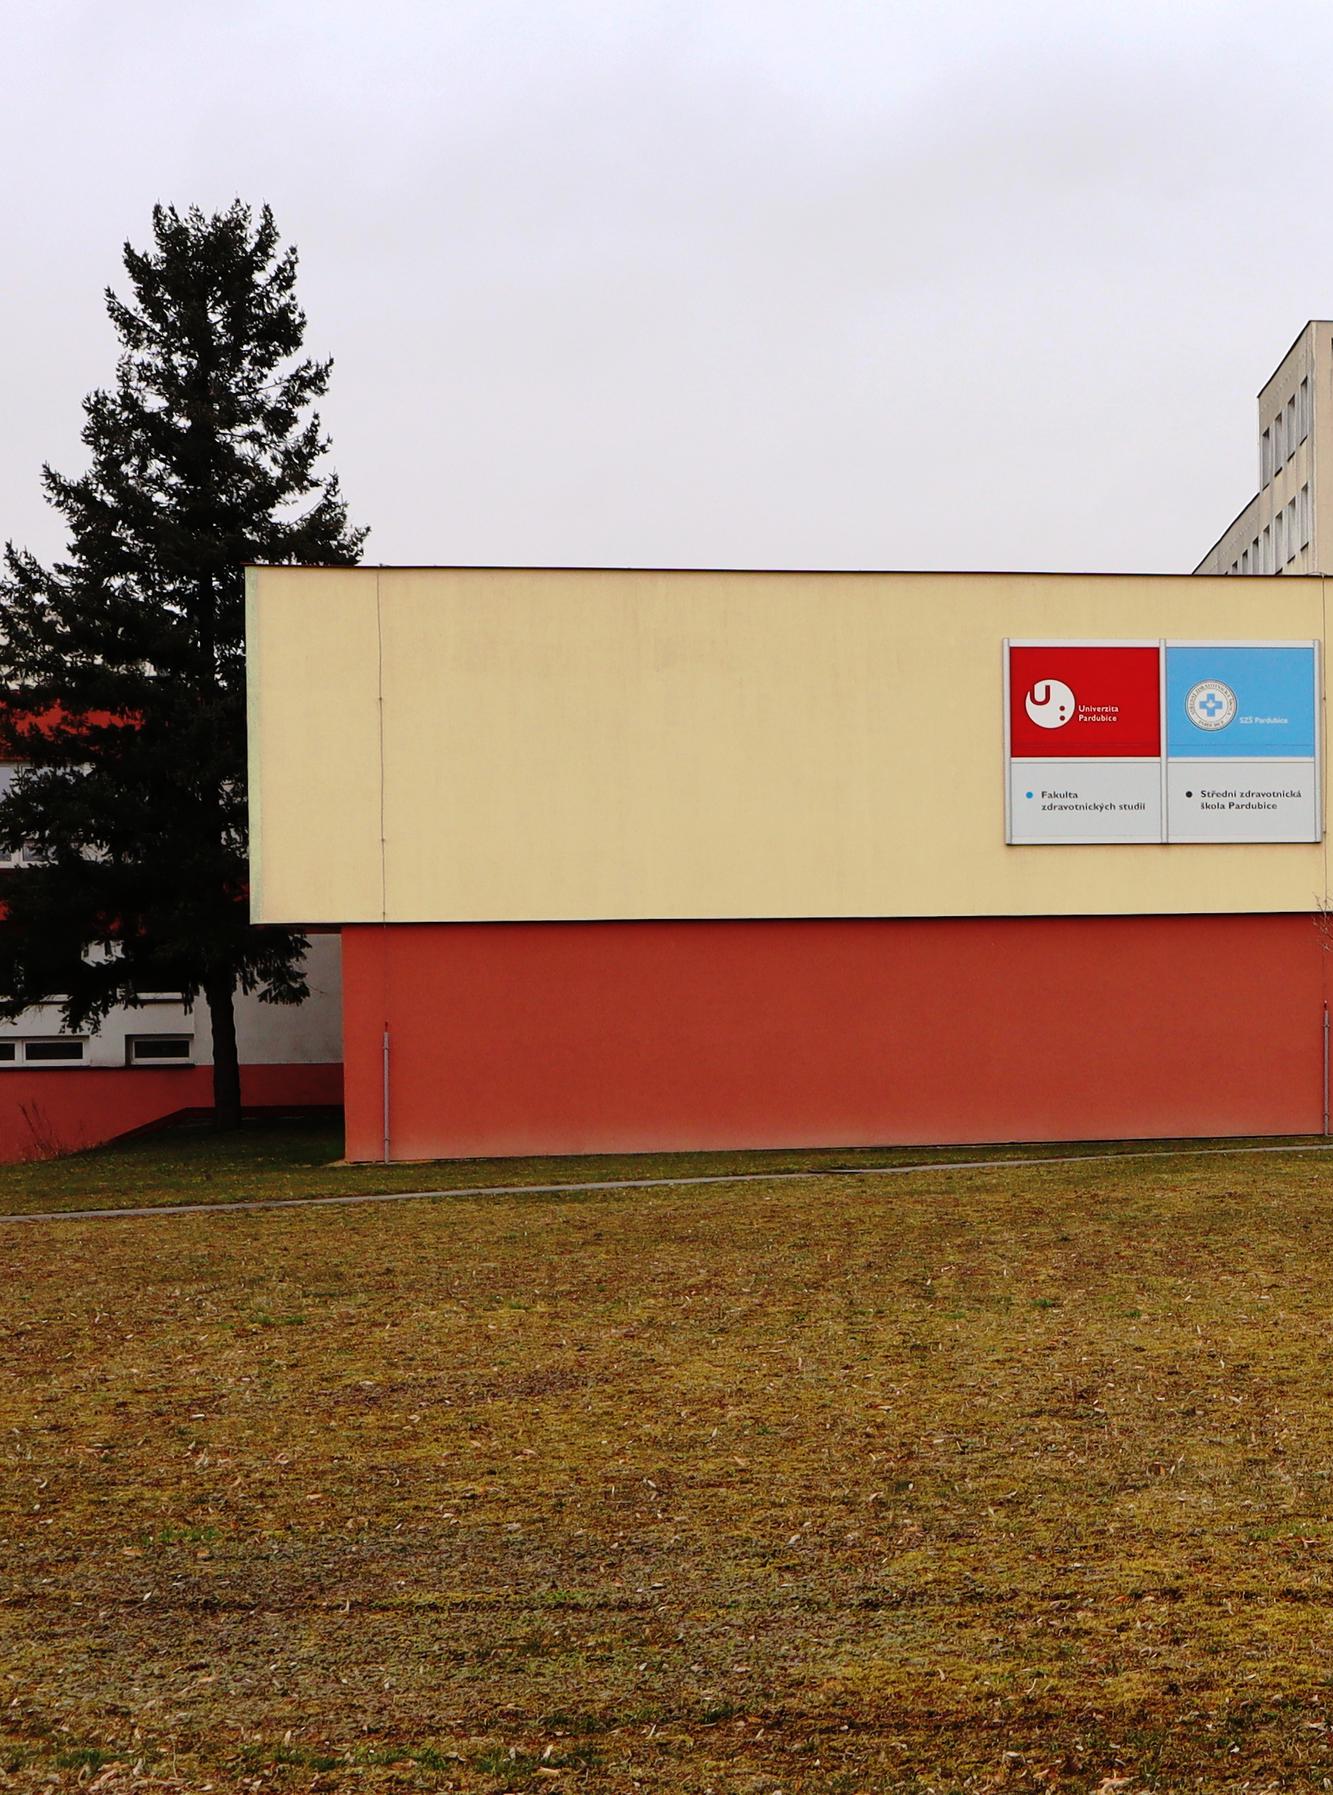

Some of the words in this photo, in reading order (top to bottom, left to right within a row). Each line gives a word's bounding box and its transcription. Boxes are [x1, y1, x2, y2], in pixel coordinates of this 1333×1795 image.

[1078, 704, 1119, 713] Univerzita
[1078, 714, 1118, 722] Pardubice
[1255, 715, 1288, 724] Pardubice
[1041, 790, 1079, 799] Fakulta
[1200, 789, 1237, 798] Střední
[1239, 789, 1302, 798] zdravotnická
[1041, 802, 1116, 813] zdravotnických
[1118, 802, 1146, 811] studií
[1200, 801, 1226, 810] škola
[1228, 801, 1278, 810] Pardubice
